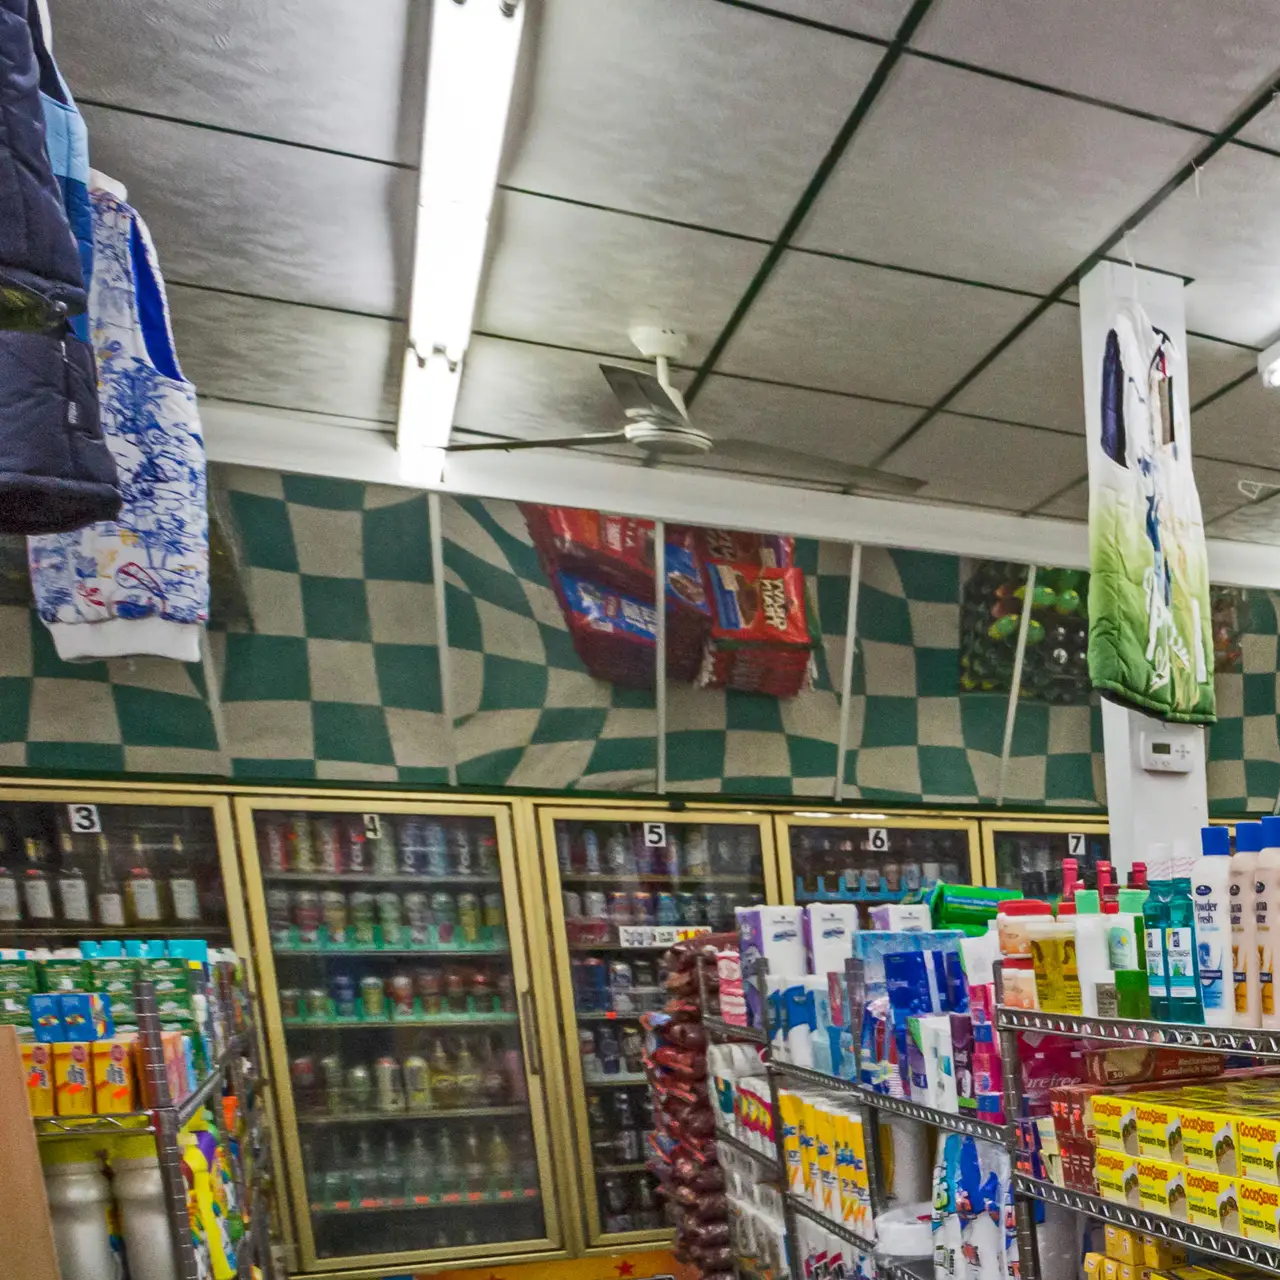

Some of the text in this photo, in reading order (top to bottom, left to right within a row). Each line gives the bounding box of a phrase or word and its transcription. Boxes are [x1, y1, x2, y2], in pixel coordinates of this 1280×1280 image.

[73, 807, 96, 831] 3
[646, 825, 665, 846] 5
[872, 830, 886, 850] 6
[1071, 836, 1083, 853] 7
